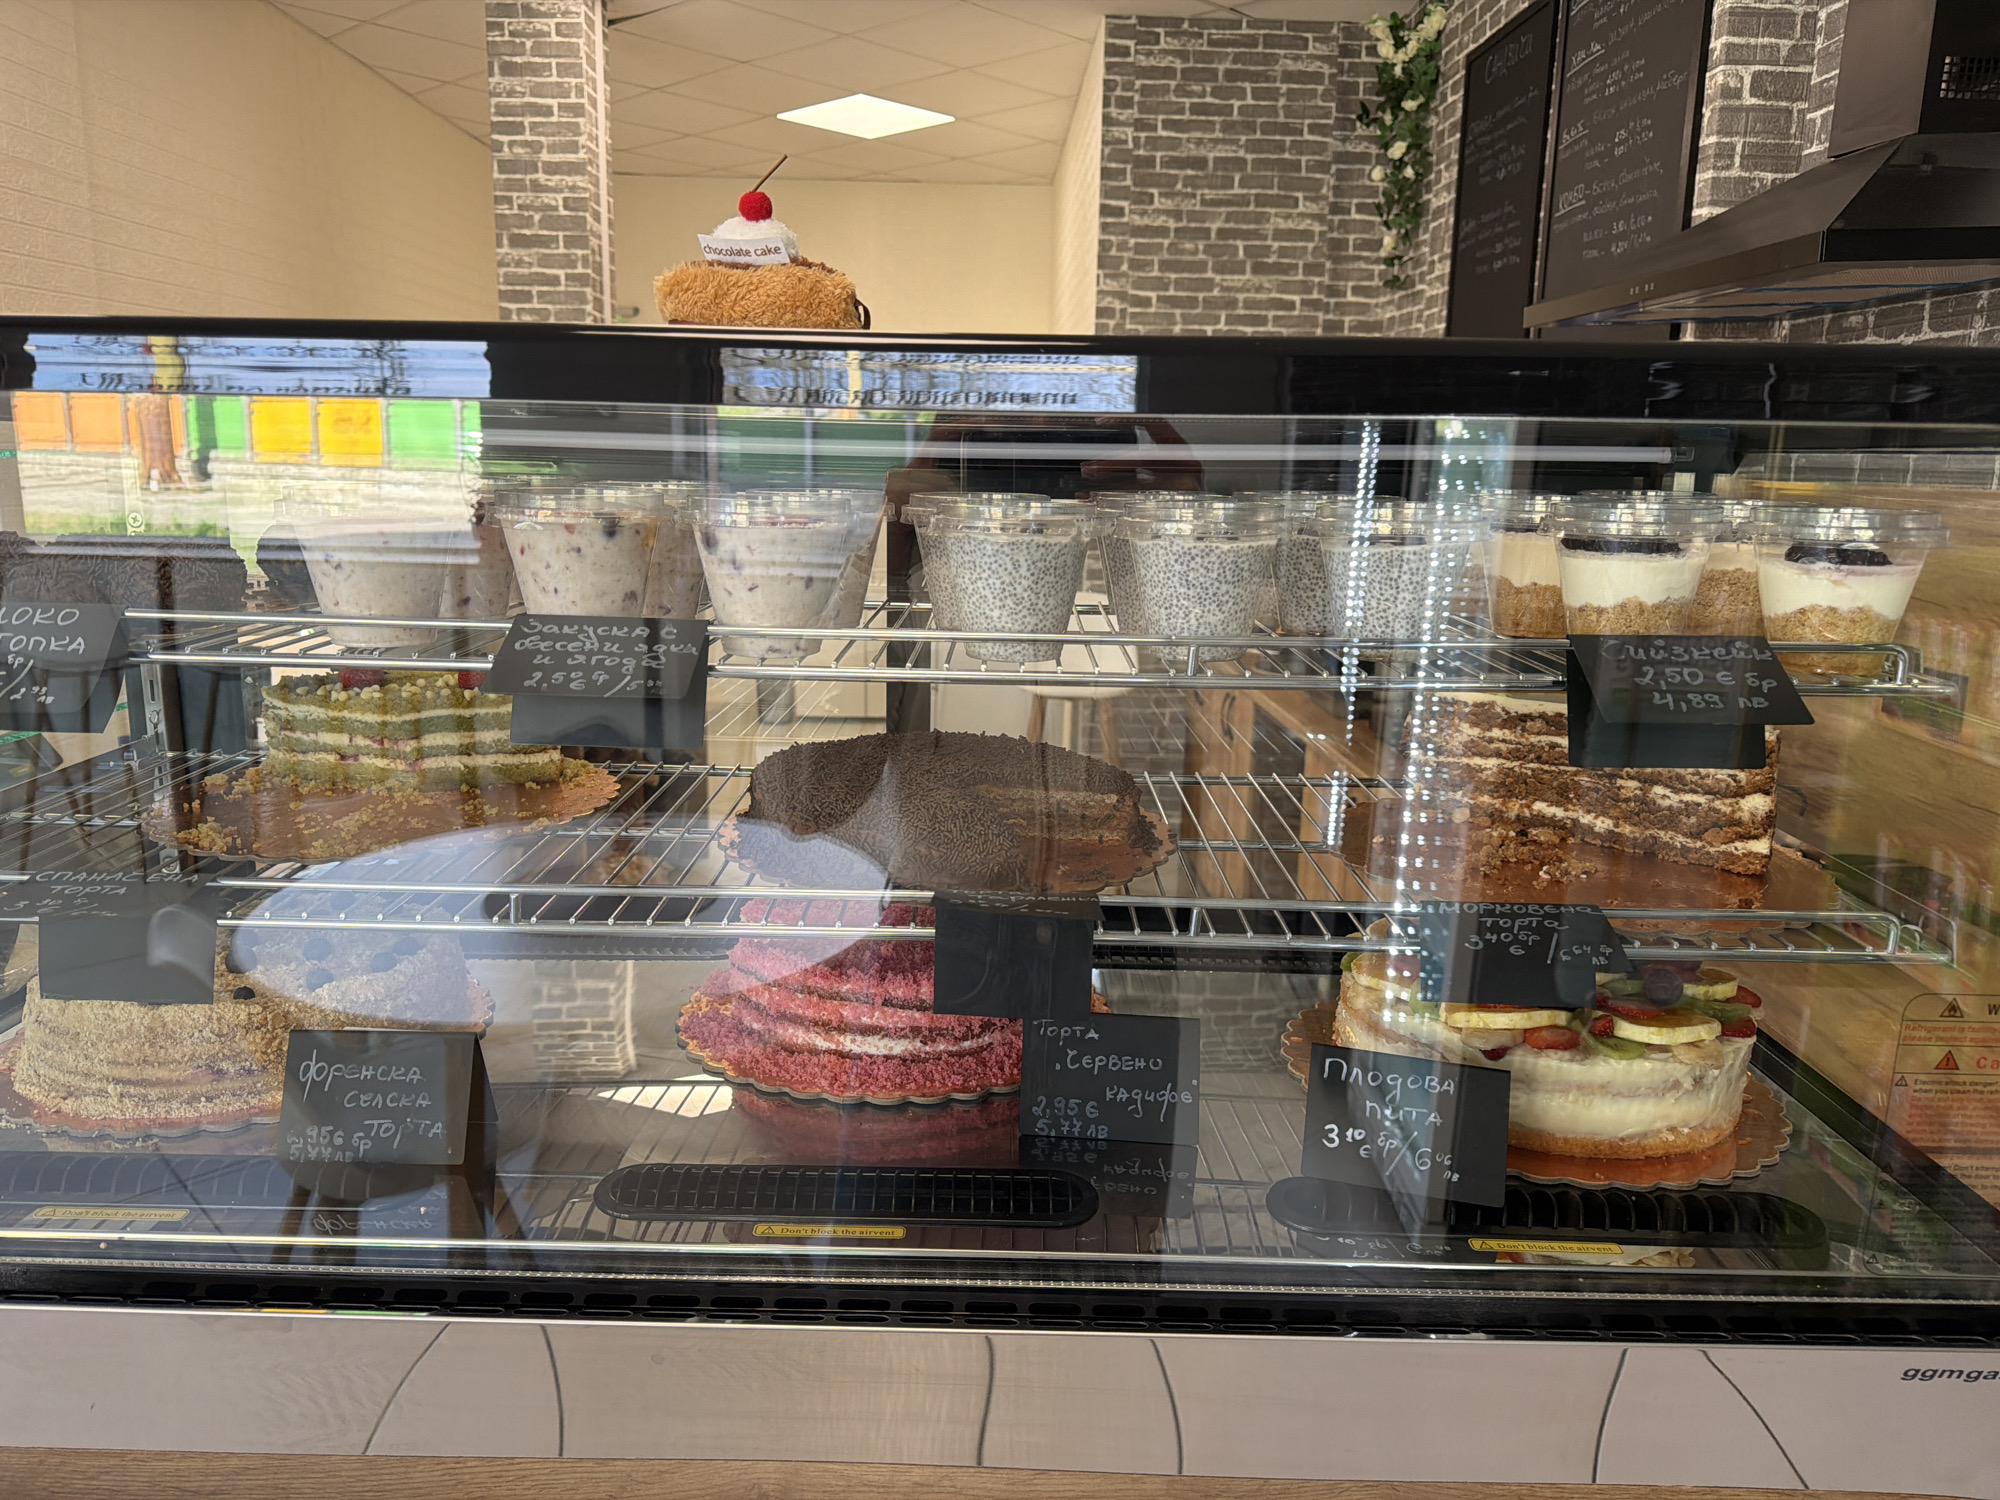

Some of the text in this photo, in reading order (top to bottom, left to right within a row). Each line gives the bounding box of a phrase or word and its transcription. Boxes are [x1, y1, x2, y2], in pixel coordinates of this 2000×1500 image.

[703, 243, 782, 257] chocolate cake
[780, 1227, 808, 1235] Don't
[841, 1228, 857, 1236] the
[1577, 1245, 1614, 1253] airvent
[1900, 1368, 2000, 1383] ggmga
